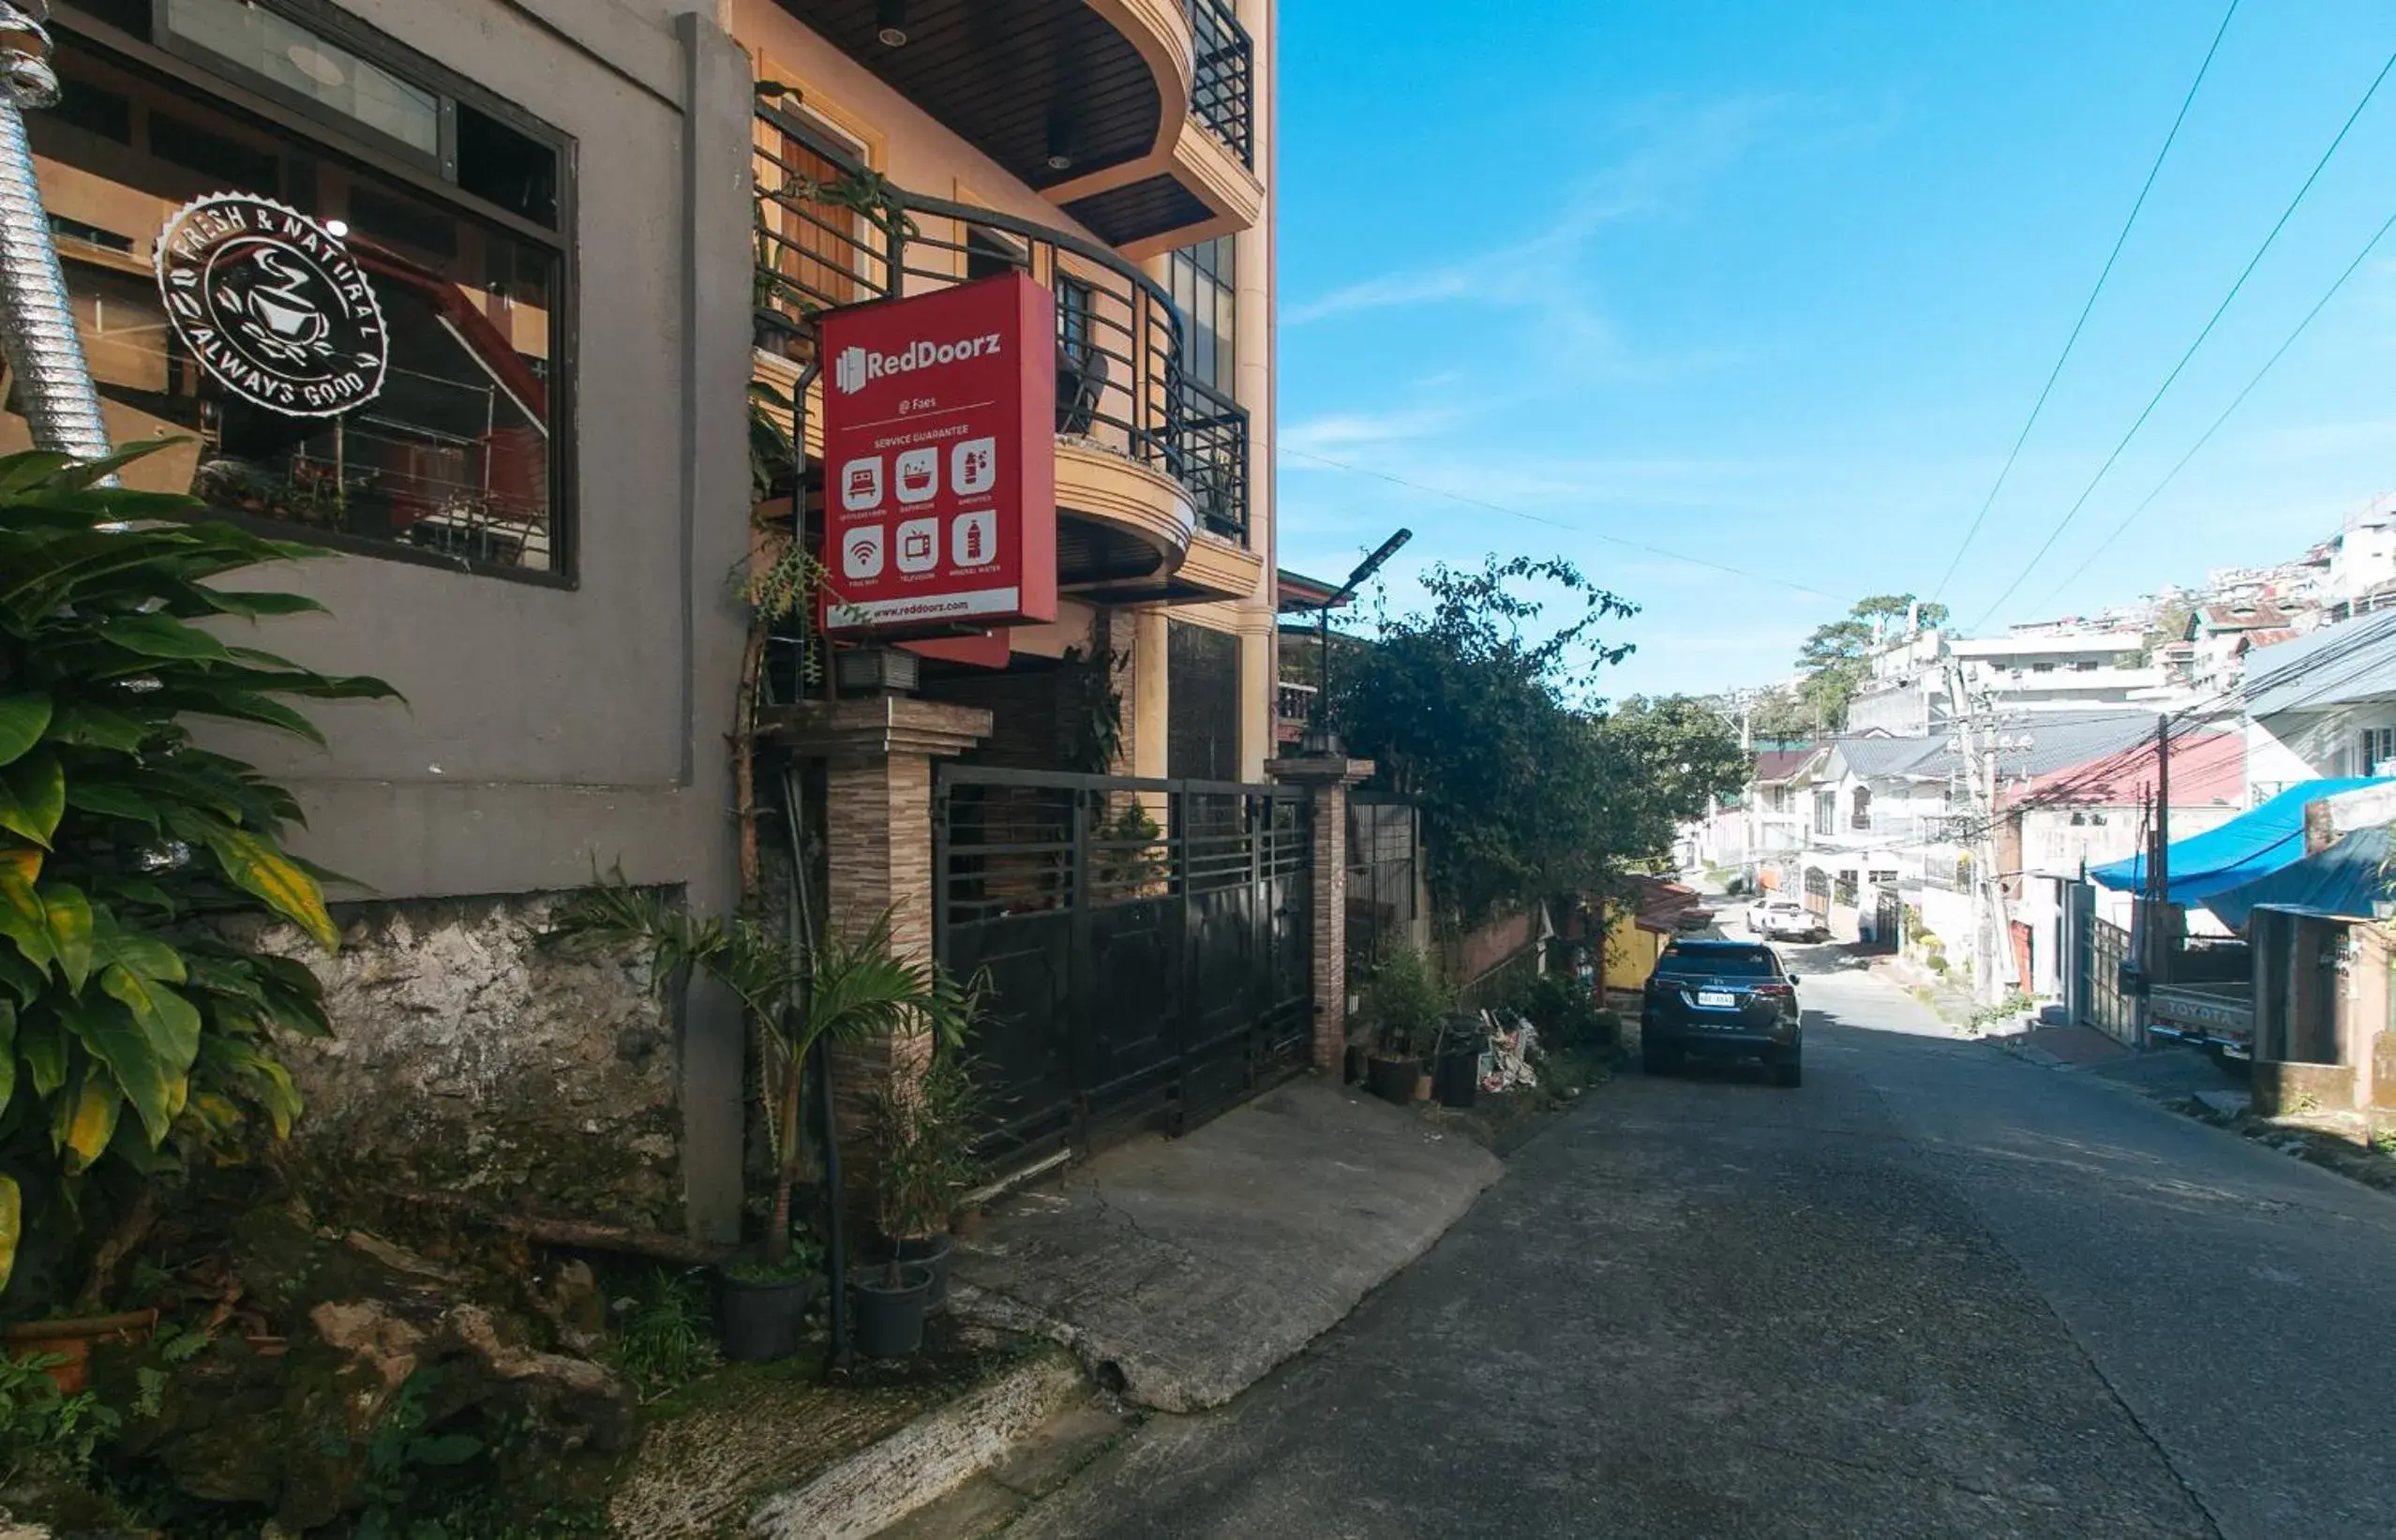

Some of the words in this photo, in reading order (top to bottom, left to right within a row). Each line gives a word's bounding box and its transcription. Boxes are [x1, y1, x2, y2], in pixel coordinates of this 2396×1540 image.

[172, 205, 247, 262] FRESH
[256, 209, 273, 231] &
[283, 217, 379, 338] NATURAL
[188, 328, 296, 403] ALWAYS
[304, 372, 364, 406] GOOD
[867, 334, 1000, 378] RedDoorz
[899, 400, 910, 414] @
[913, 397, 936, 410] Faes
[874, 434, 911, 448] SERVICE
[913, 425, 969, 441] GUARANTEE
[900, 573, 935, 582] TELEVISION
[874, 601, 968, 618] www.reddoorz.com
[2168, 1001, 2232, 1024] TOYOTA
